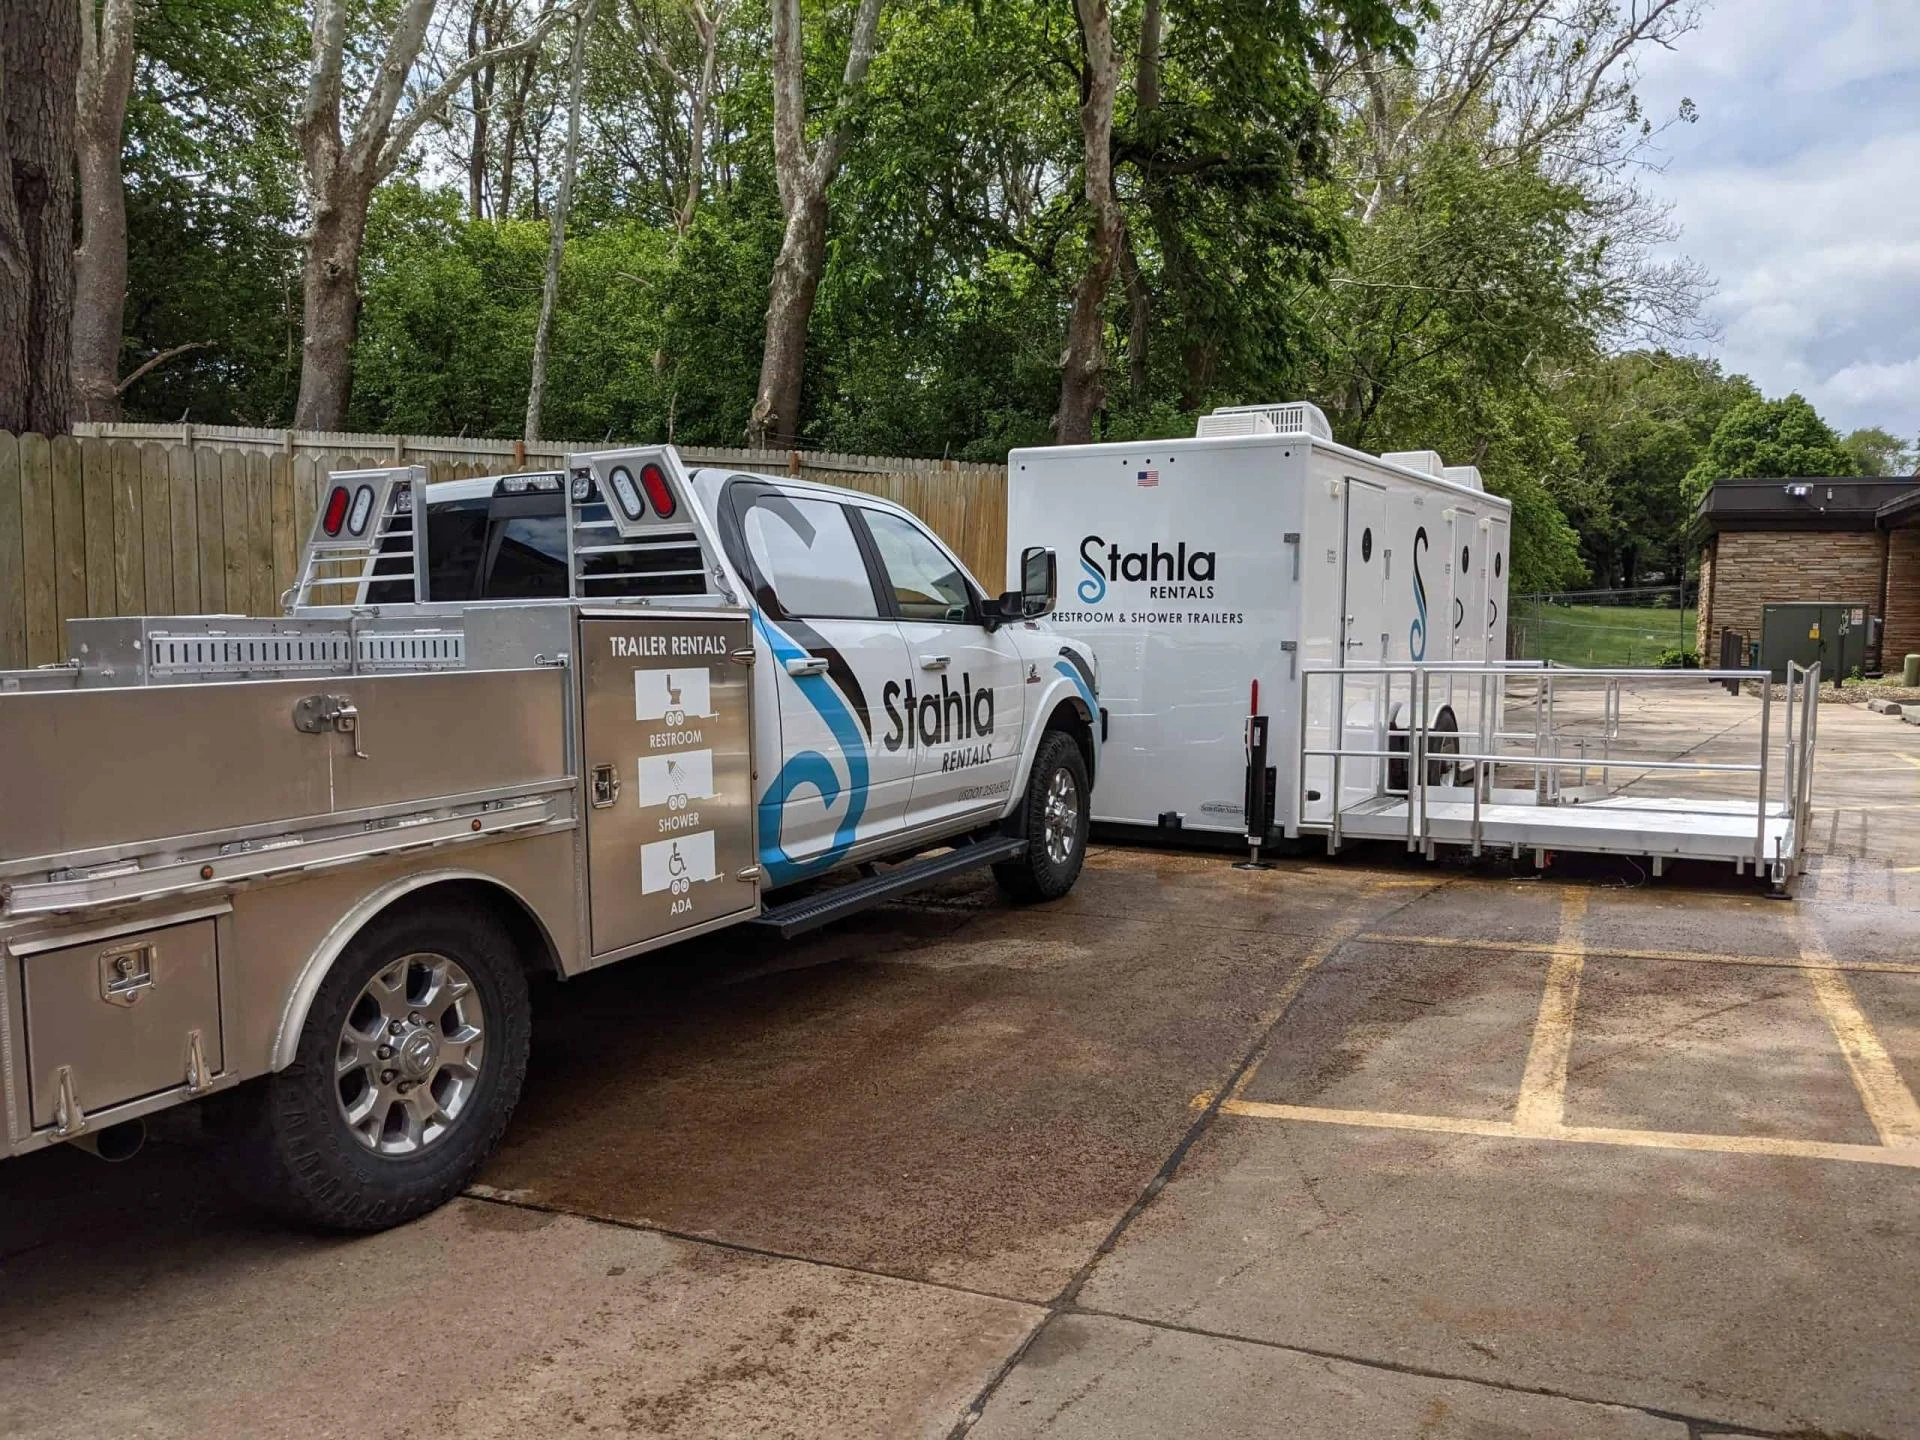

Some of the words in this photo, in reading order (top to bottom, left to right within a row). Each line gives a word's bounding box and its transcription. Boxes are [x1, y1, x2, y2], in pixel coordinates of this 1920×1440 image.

[1078, 535, 1216, 605] Stahla
[1150, 586, 1214, 600] RENTALS
[1051, 612, 1114, 623] RESTROOM
[1118, 613, 1126, 623] &
[1131, 612, 1183, 624] SHOWER
[1188, 613, 1244, 624] TRAILERS
[609, 636, 667, 657] TRAILER
[672, 635, 727, 655] RENTALS
[883, 672, 994, 753] Stahla
[649, 729, 703, 748] RESTROOM
[941, 743, 992, 773] RENTALS
[958, 786, 983, 802] USDOT
[658, 812, 700, 833] SHOWER
[670, 897, 693, 916] ADA
